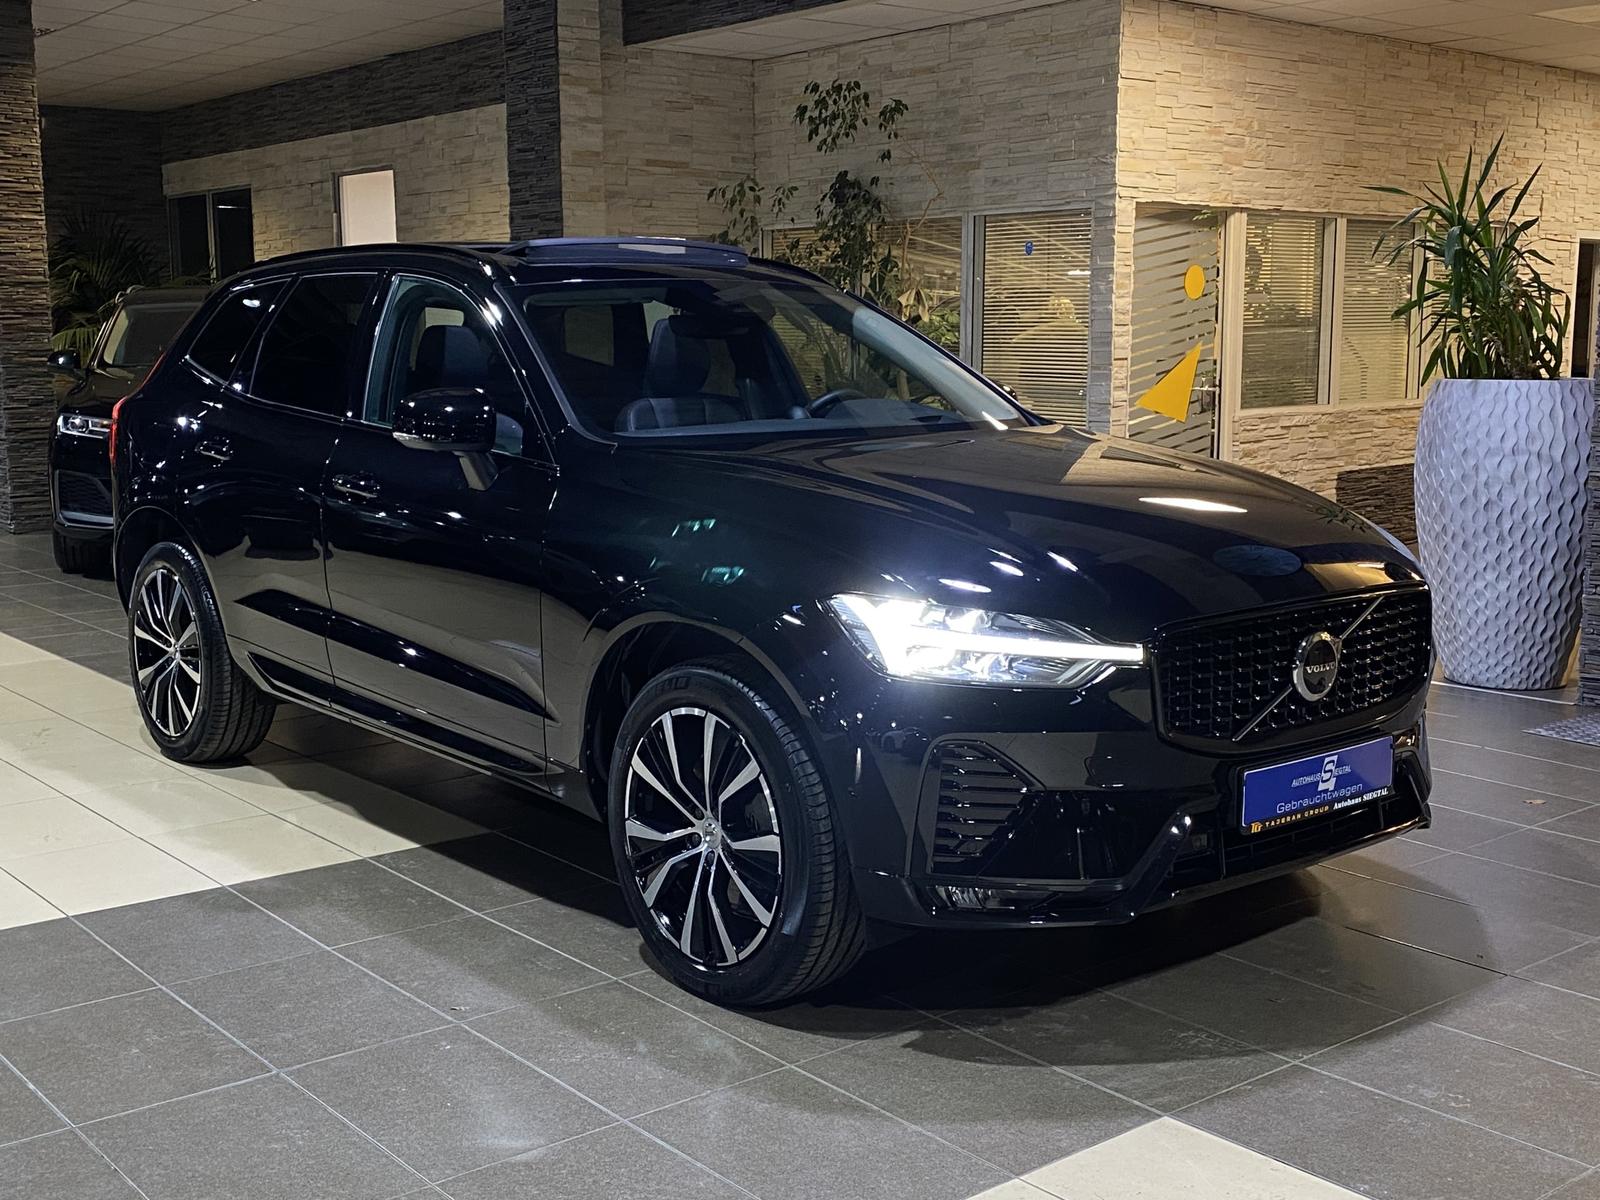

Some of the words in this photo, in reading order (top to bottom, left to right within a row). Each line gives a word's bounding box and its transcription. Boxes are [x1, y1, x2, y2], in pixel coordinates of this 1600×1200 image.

[1306, 661, 1336, 673] VOLVO
[1291, 772, 1321, 787] AUTOHAUS
[1276, 782, 1363, 814] Gebrauchtwagen
[1333, 797, 1362, 810] Autohaus
[1362, 787, 1389, 802] SIEGTAL
[1265, 813, 1301, 828] TAJERAN
[1304, 805, 1329, 817] GROUP
